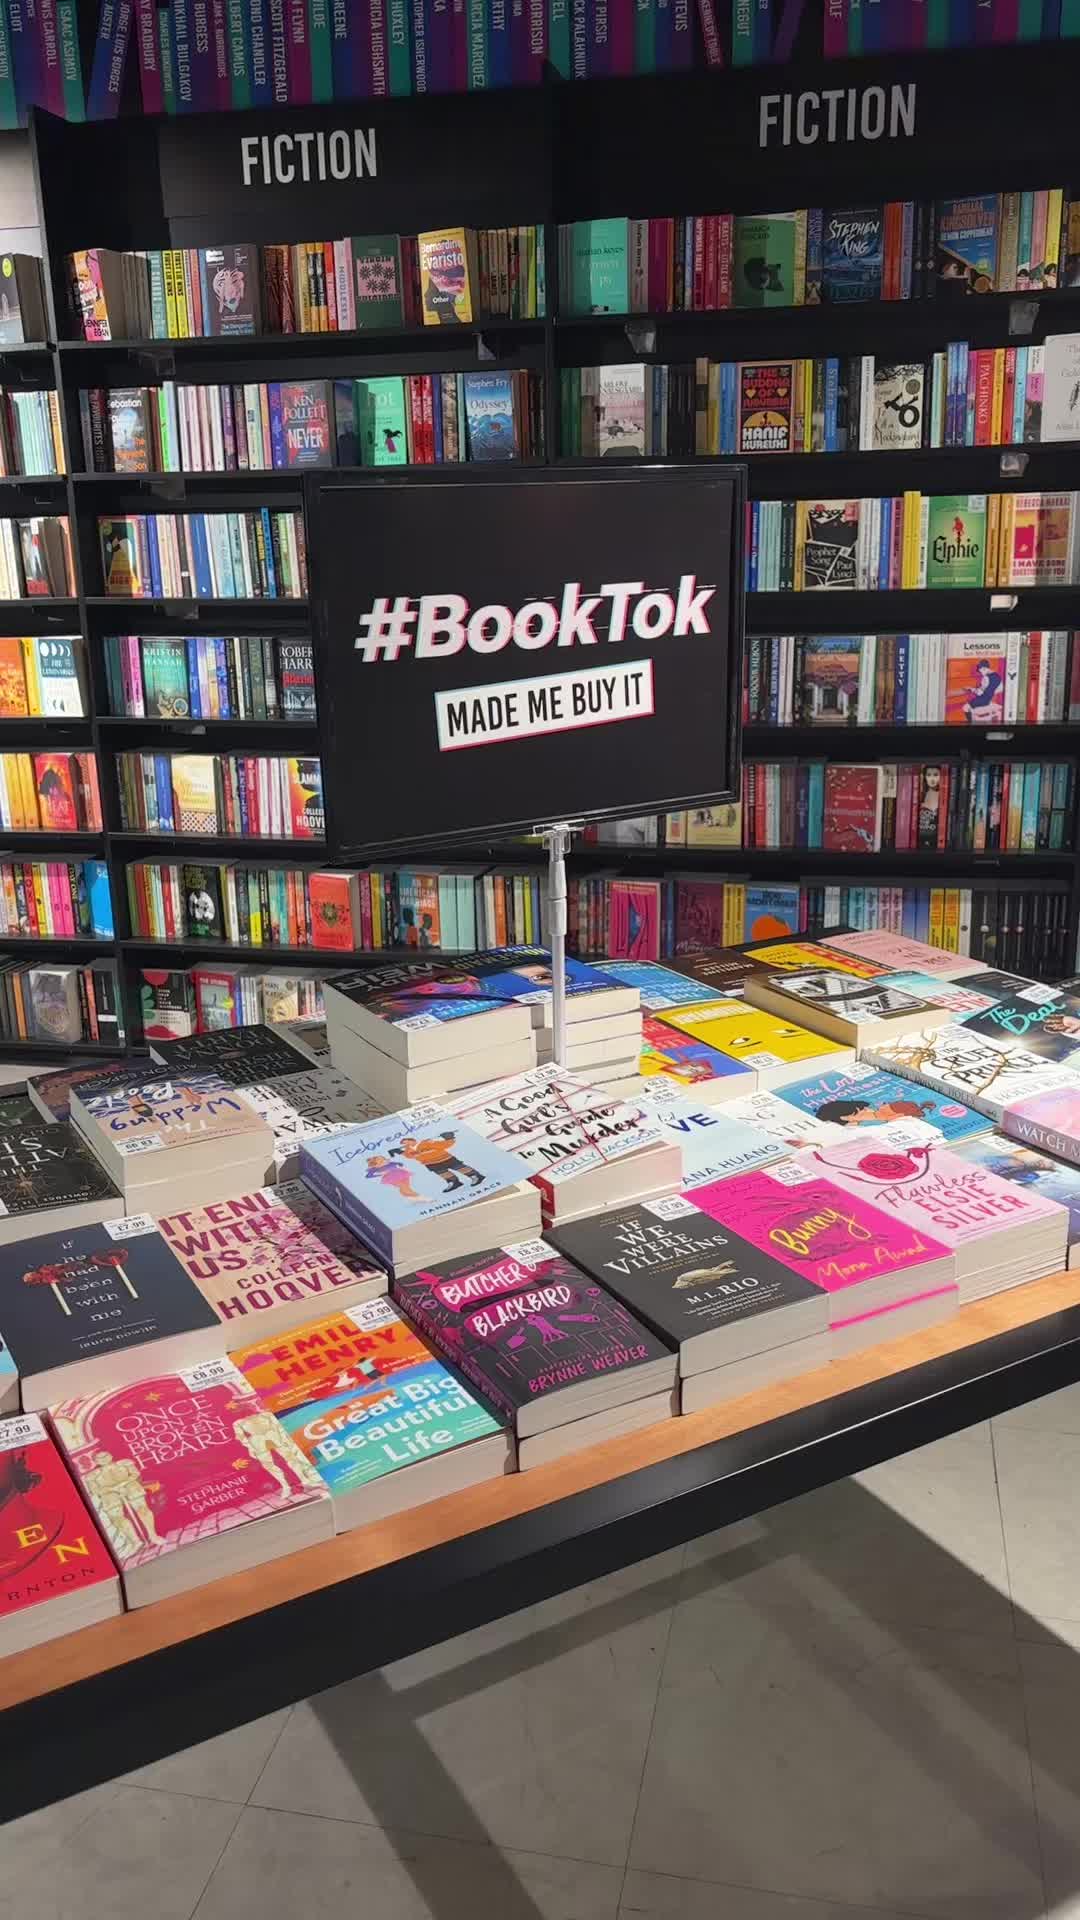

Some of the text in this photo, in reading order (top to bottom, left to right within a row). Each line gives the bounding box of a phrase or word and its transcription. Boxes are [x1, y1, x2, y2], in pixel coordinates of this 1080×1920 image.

[10, 4, 23, 33] ELIOT
[100, 3, 114, 40] AUSTER
[194, 3, 208, 53] BURGESS
[291, 8, 305, 44] FLYNN
[391, 2, 405, 46] HUXLEY
[596, 7, 608, 44] PIRSIG
[43, 23, 57, 68] CARROLL
[60, 6, 77, 81] ISAAC ASIMOV
[108, 2, 130, 93] JORGE LUIS BORGES
[141, 13, 156, 71] BRADBURY
[232, 37, 245, 76] CAMUS
[251, 26, 266, 85] CHANDLER
[574, 17, 587, 79] PALAHNIUK
[177, 44, 192, 101] BULGAKOV
[272, 37, 288, 102] FITZGERALD
[371, 32, 386, 96] HIGHSMITH
[415, 39, 427, 93] ISHERWOOD
[472, 33, 486, 88] MARQUEZ
[759, 84, 917, 148] FICTION
[240, 128, 378, 186] FICTION
[828, 219, 880, 240] STEPHEN
[840, 236, 870, 257] KING
[164, 252, 173, 270] FIRST
[174, 252, 183, 270] FIRST
[421, 250, 464, 270] Evaristo
[338, 265, 348, 322] MIDDLESEX
[432, 295, 449, 304] Other
[294, 395, 314, 408] KEN
[469, 399, 511, 411] Odyssey
[978, 364, 991, 424] PACHINKO
[283, 404, 327, 424] FOLLETT
[287, 426, 325, 449] NEVER
[742, 425, 788, 440] HANIF
[742, 439, 788, 450] KUREISHI
[810, 557, 831, 568] Song
[836, 560, 853, 571] Paul
[932, 535, 980, 564] Elphie
[832, 568, 857, 580] Lynch
[353, 574, 718, 663] #BookTok
[143, 647, 182, 657] KRISTIN
[963, 642, 1001, 650] Lessons
[751, 640, 760, 699] NORTH WOODS
[446, 671, 644, 738] MADE ME BUY IT
[337, 962, 449, 990] WEIR
[367, 974, 418, 992] ANDY
[980, 1006, 1016, 1025] The
[1000, 1001, 1067, 1036] Deal
[930, 1047, 1001, 1070] CRUEL
[941, 1054, 1044, 1083] PRINCE
[110, 1096, 242, 1131] Wedding
[483, 1081, 565, 1123] A Good
[500, 1098, 573, 1136] Girl's
[537, 1110, 642, 1164] Murder
[544, 1105, 616, 1137] Guide
[1016, 1119, 1067, 1152] WATCH
[552, 1127, 661, 1175] HOLLY JACKSON
[681, 1144, 780, 1186] ANA HUANG
[420, 1181, 503, 1216] HANNAH GRACE
[873, 1169, 988, 1209] Flawless
[915, 1184, 995, 1214] ELSIE
[117, 1219, 146, 1232] £7.99
[157, 1191, 274, 1237] IT EN
[616, 1219, 642, 1234] IF
[931, 1194, 1032, 1231] SILVER
[61, 1239, 75, 1250] if
[170, 1212, 284, 1257] WITH
[613, 1224, 673, 1247] WE
[621, 1232, 694, 1258] WERE
[768, 1207, 872, 1256] Bunny
[63, 1253, 87, 1264] he
[186, 1249, 248, 1280] US
[517, 1245, 545, 1258] £8.99
[602, 1234, 730, 1276] VILLAINS
[814, 1234, 929, 1283] Mona Awad
[63, 1265, 101, 1278] had
[65, 1277, 113, 1295] been
[236, 1254, 334, 1290] COLLEEN
[439, 1262, 528, 1305] BUTCHER
[718, 1276, 760, 1297] RIO
[75, 1292, 120, 1308] with
[216, 1260, 378, 1320] HOOVER
[90, 1308, 123, 1322] me
[361, 1304, 391, 1322] £7.99
[471, 1284, 572, 1337] BLACKBIRD
[79, 1325, 158, 1350] laura nowlin
[270, 1323, 362, 1363] EMIL
[273, 1327, 397, 1382] HENRY
[192, 1366, 225, 1381] £8.99
[528, 1364, 587, 1394] BRYNNE
[591, 1344, 649, 1372] WEAVER
[115, 1393, 214, 1432] ONCE
[303, 1392, 405, 1441] Great
[402, 1374, 462, 1402] Big
[315, 1388, 478, 1462] Beautiful
[123, 1415, 184, 1442] UPON
[128, 1415, 225, 1457] BROKEN
[382, 1429, 455, 1463] Life
[135, 1427, 236, 1470] HEART
[176, 1475, 249, 1505] STEPHANIE
[190, 1487, 247, 1514] GARBER
